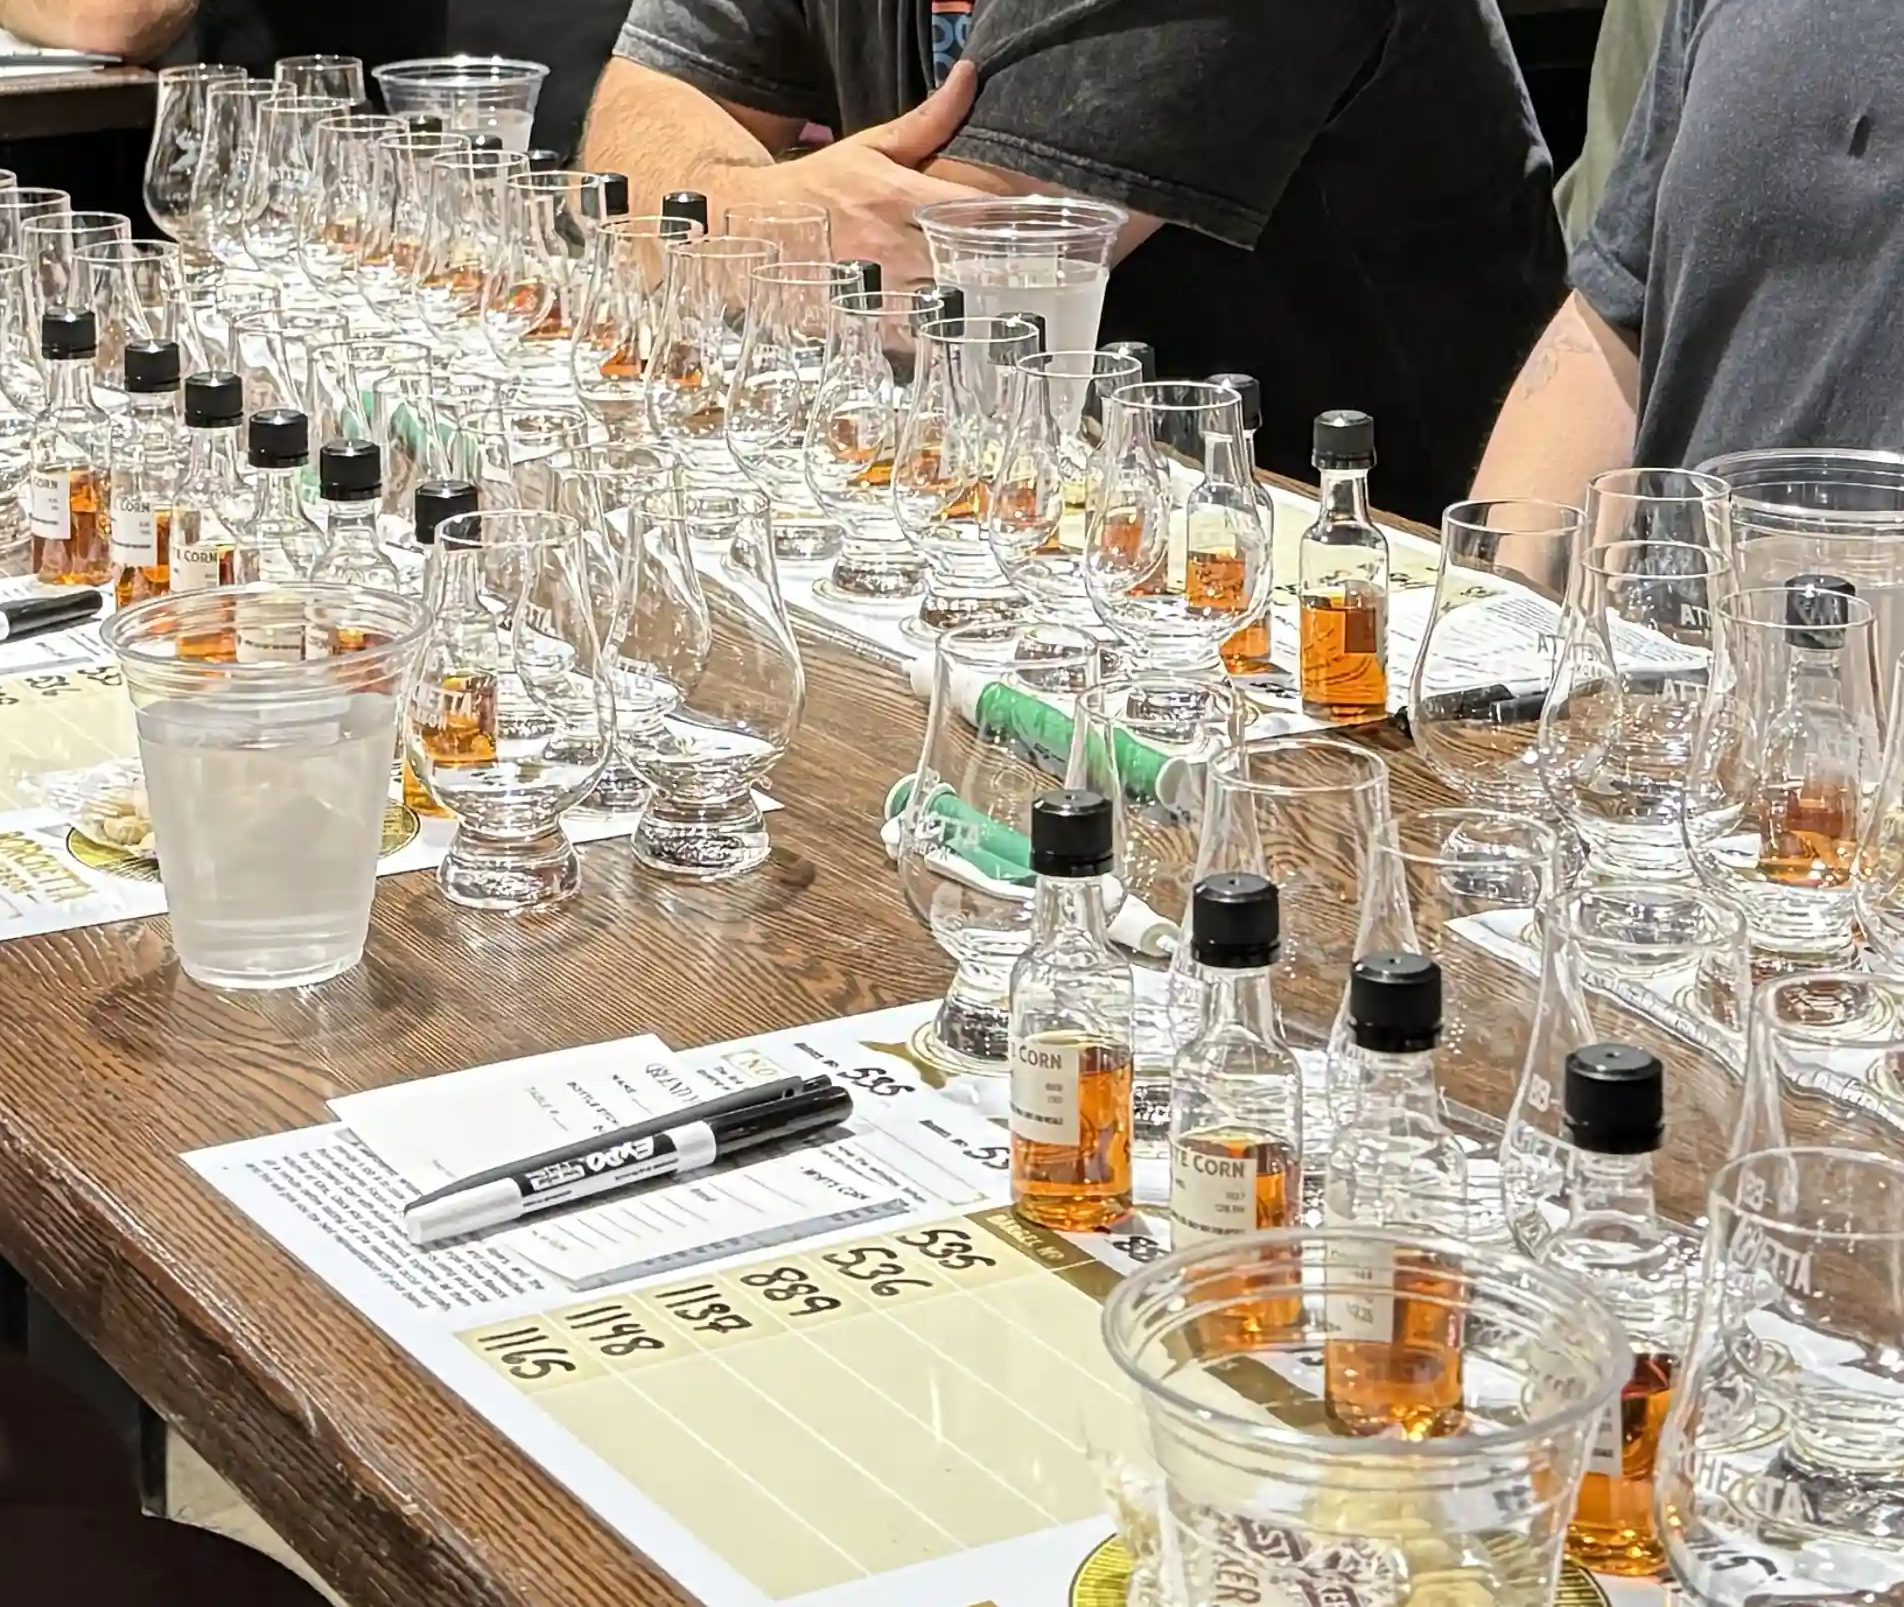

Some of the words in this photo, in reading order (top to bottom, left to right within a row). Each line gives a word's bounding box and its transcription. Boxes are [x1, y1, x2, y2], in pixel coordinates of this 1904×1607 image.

[119, 498, 151, 514] CORN
[183, 548, 218, 565] CORN
[1019, 1045, 1063, 1070] CORN
[586, 1135, 656, 1175] EXPO
[963, 1145, 1010, 1171] 53
[1192, 1154, 1245, 1178] CORN
[896, 1228, 998, 1270] 535
[1113, 1235, 1170, 1263] 88
[822, 1245, 934, 1297] 536
[740, 1266, 843, 1316] 889
[566, 1304, 666, 1357] 1148
[478, 1326, 577, 1382] 1165
